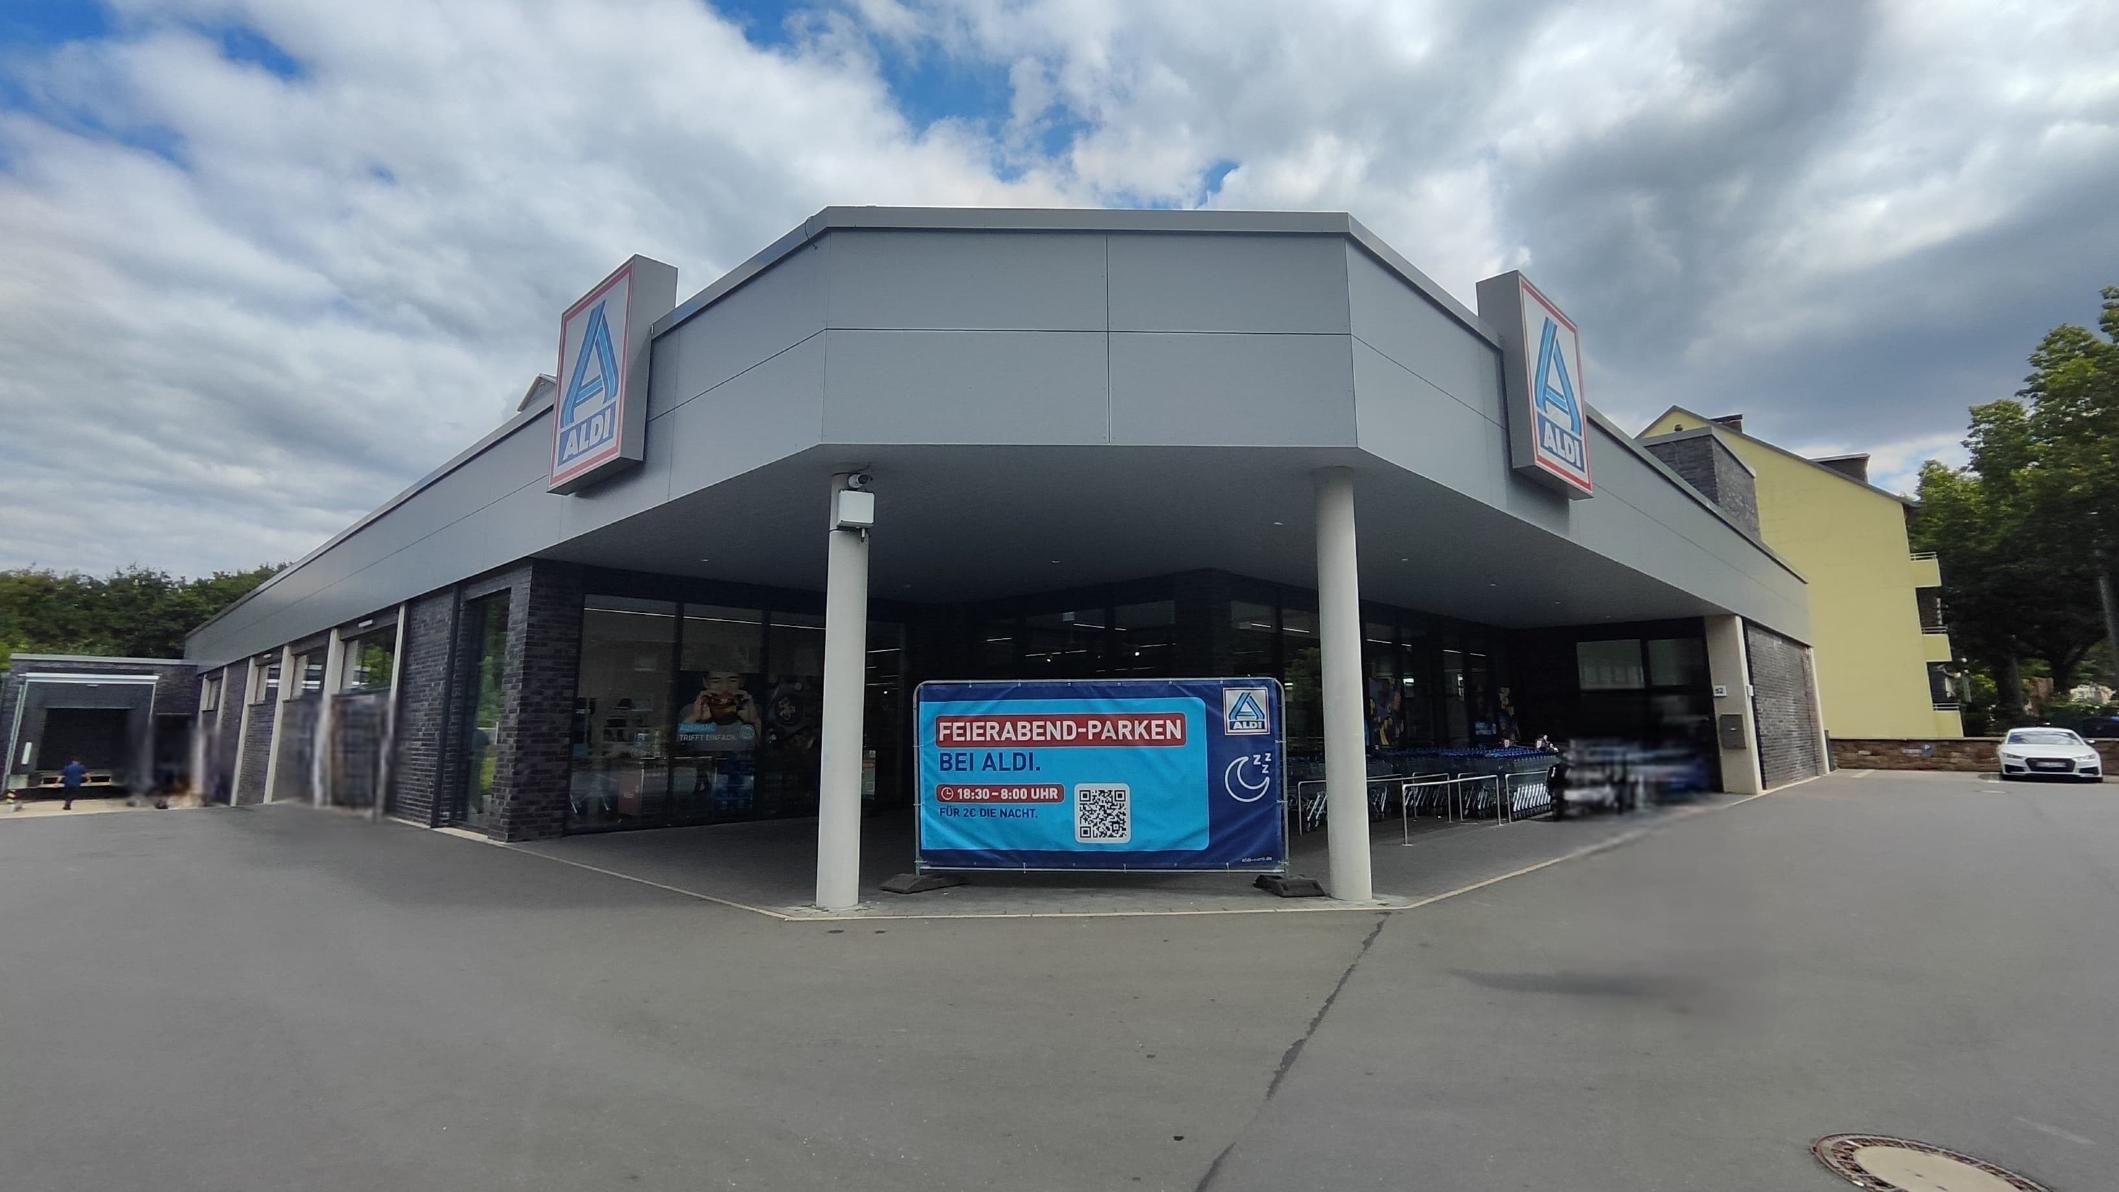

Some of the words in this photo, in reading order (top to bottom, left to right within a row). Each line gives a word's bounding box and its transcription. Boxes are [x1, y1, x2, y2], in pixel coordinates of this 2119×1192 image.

[563, 407, 611, 460] ALDI
[1543, 421, 1582, 468] ALDI
[939, 719, 1182, 741] FEIERABEND-PARKEN
[1233, 721, 1263, 730] ALDI
[939, 752, 974, 771] BEI
[982, 751, 1041, 771] ALDI.
[957, 788, 990, 800] 18:30
[1000, 788, 1028, 800] 8:00
[1030, 787, 1058, 799] UHR
[939, 806, 960, 818] FÜR
[963, 808, 976, 817] 2€
[980, 808, 997, 818] DIE
[1000, 808, 1039, 818] NACHT.
